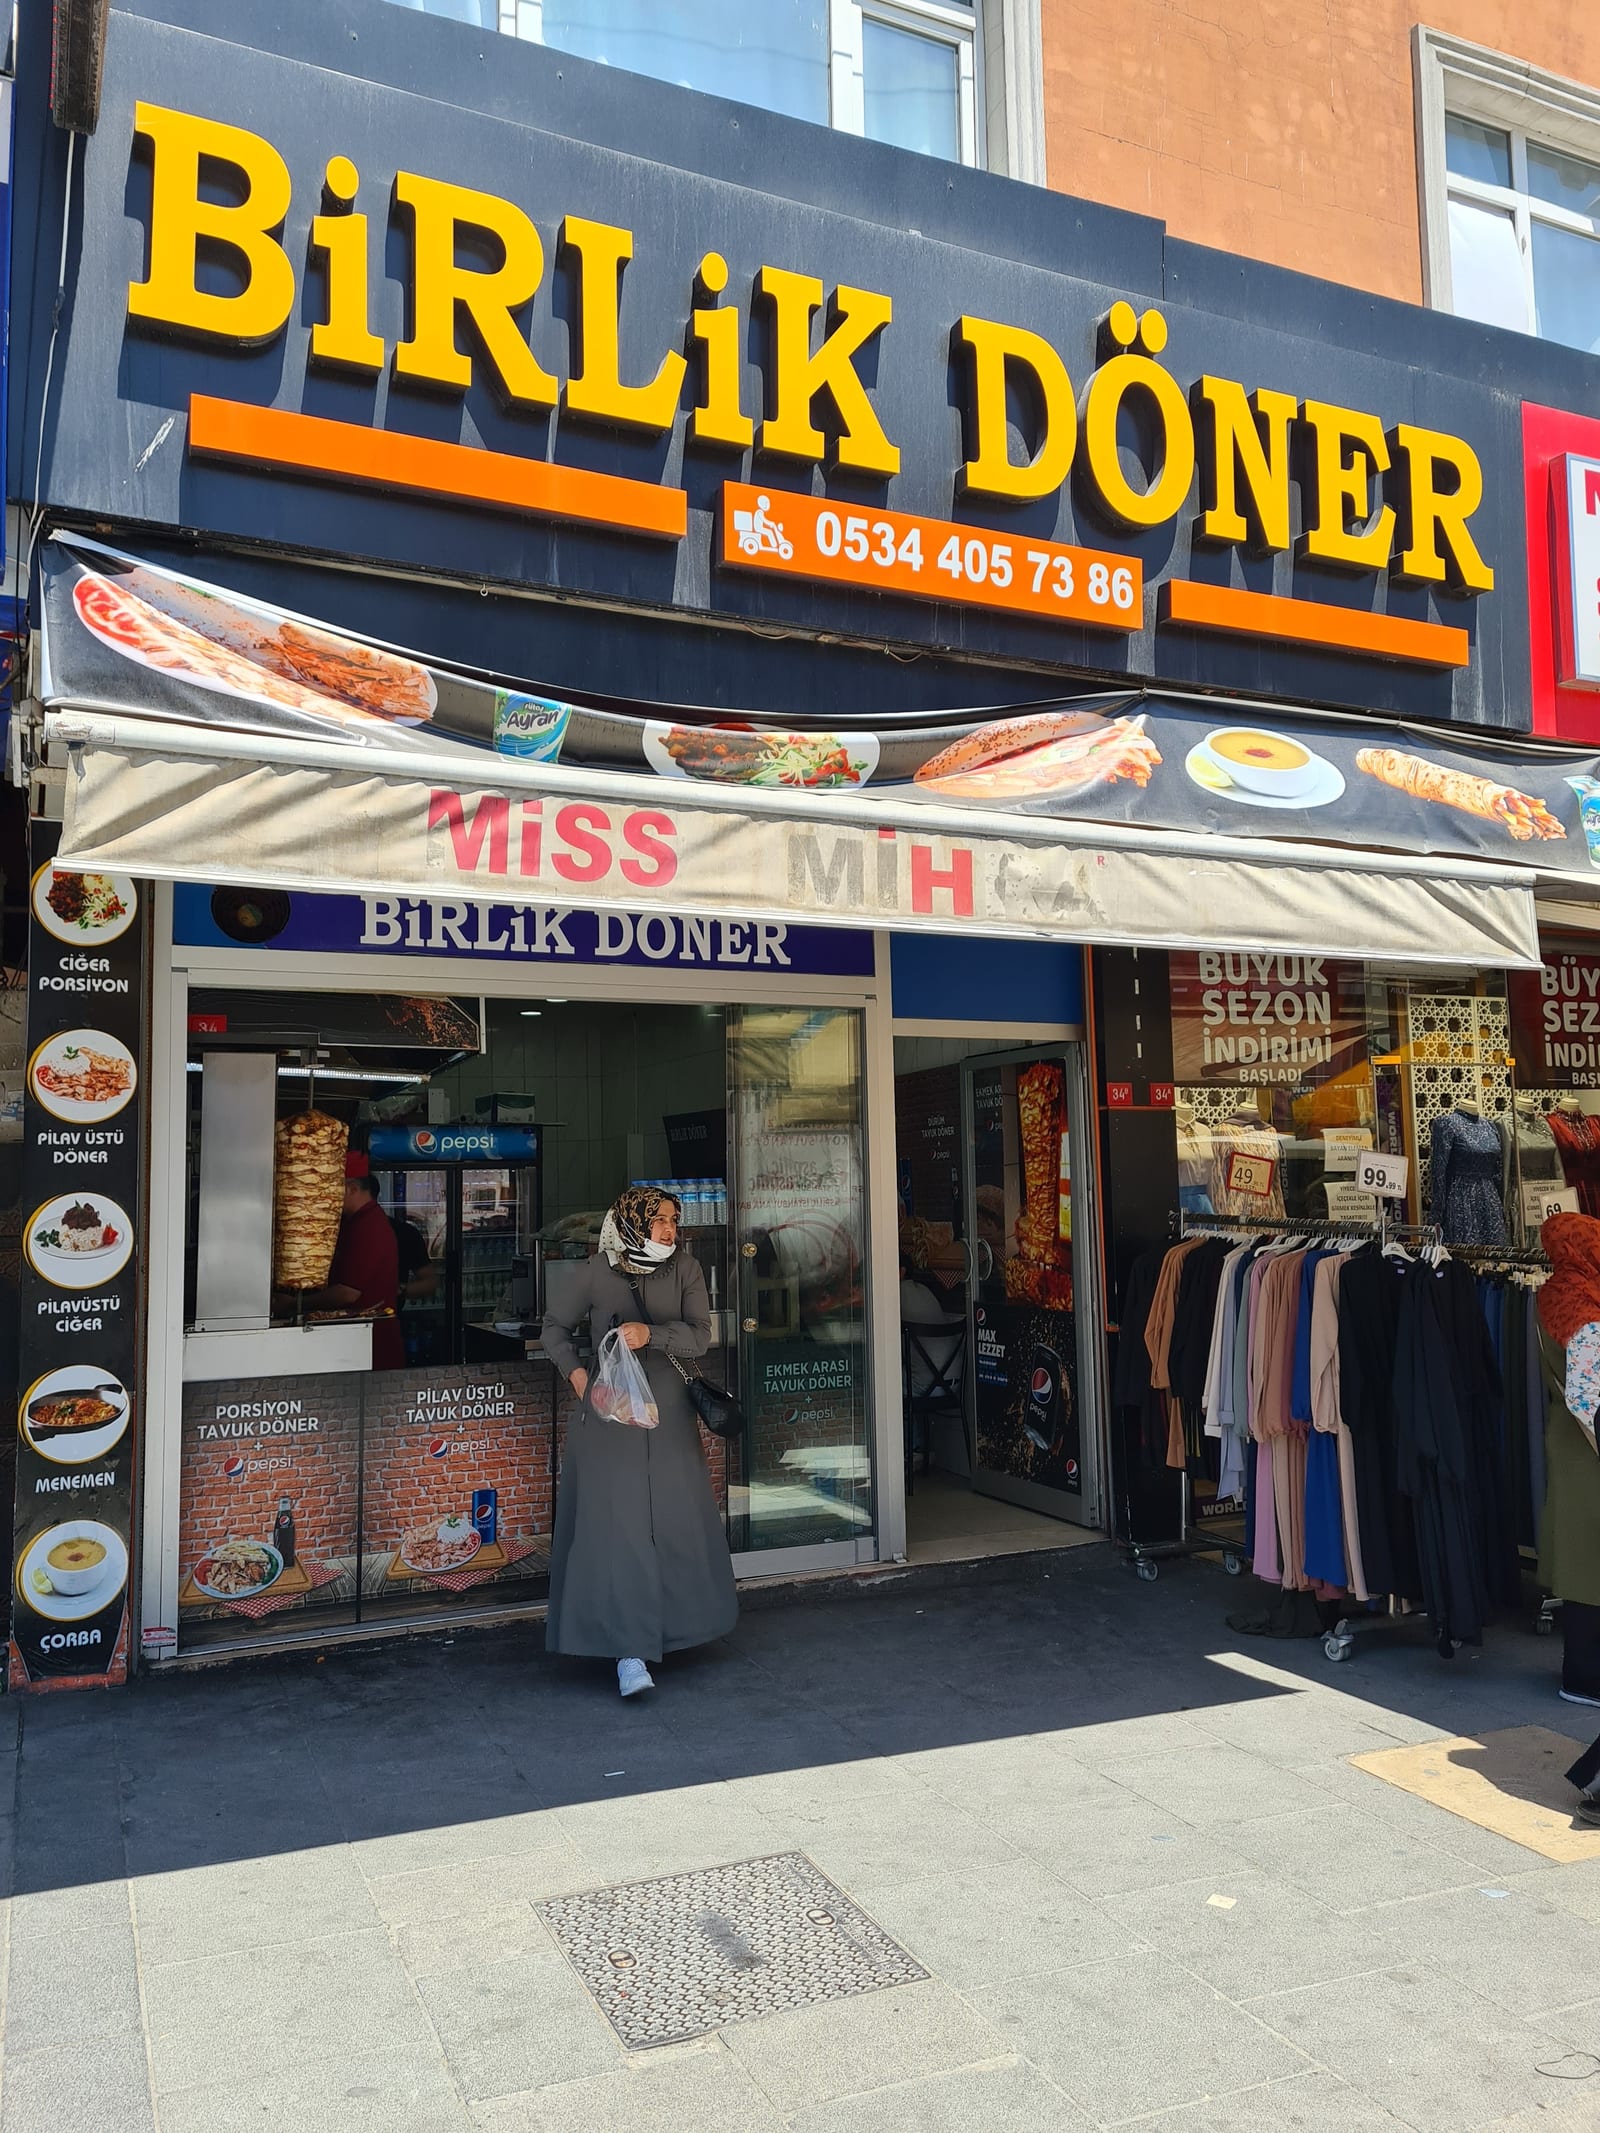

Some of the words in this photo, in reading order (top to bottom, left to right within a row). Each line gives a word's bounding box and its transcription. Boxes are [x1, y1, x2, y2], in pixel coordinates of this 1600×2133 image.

[960, 300, 1495, 592] DÖNER
[815, 511, 923, 573] 0534
[937, 540, 1012, 588] 405
[1026, 551, 1074, 600] 73
[1088, 561, 1134, 610] 86
[507, 711, 560, 730] Ayran
[59, 954, 110, 974] CİĞER
[38, 972, 129, 994] PORSİYON
[1540, 956, 1600, 998] BÜY
[1202, 991, 1331, 1026] SEZON
[1542, 1000, 1600, 1033] SEZ
[1203, 1027, 1332, 1064] İNDİRİMİ
[1544, 1033, 1600, 1068] İNDİ
[1239, 1067, 1302, 1086] BAŞLADI
[37, 1129, 83, 1148] PİLAV
[85, 1129, 124, 1146] ÜSTÜ
[1388, 1111, 1398, 1154] WORL
[441, 1133, 495, 1153] pepsi
[52, 1147, 109, 1165] DÖNER
[1234, 1167, 1253, 1184] 49
[1546, 1203, 1562, 1216] 69
[36, 1296, 121, 1316] PİLAVÜSTÜ
[55, 1314, 103, 1334] CİĞER
[978, 1328, 996, 1343] MAX
[978, 1342, 1006, 1358] LEZZET
[766, 1362, 809, 1377] EKMEK
[812, 1359, 849, 1374] ARASI
[417, 1387, 463, 1405] PİLAV
[466, 1382, 505, 1400] ÜSTÜ
[763, 1379, 806, 1393] TAVUK
[809, 1374, 852, 1390] DÖNER
[216, 1399, 302, 1420] PORSİYON
[406, 1406, 458, 1423] TAVUK
[462, 1401, 515, 1419] DÖNER
[801, 1406, 833, 1423] pepsi
[1029, 1402, 1047, 1422] pepsi
[197, 1422, 256, 1439] TAVUK
[259, 1416, 319, 1435] DÖNER
[451, 1438, 490, 1454] pepsi
[248, 1455, 292, 1473] pepsi
[35, 1471, 116, 1493] MENEMEN
[40, 1628, 102, 1653] ÇORBA
